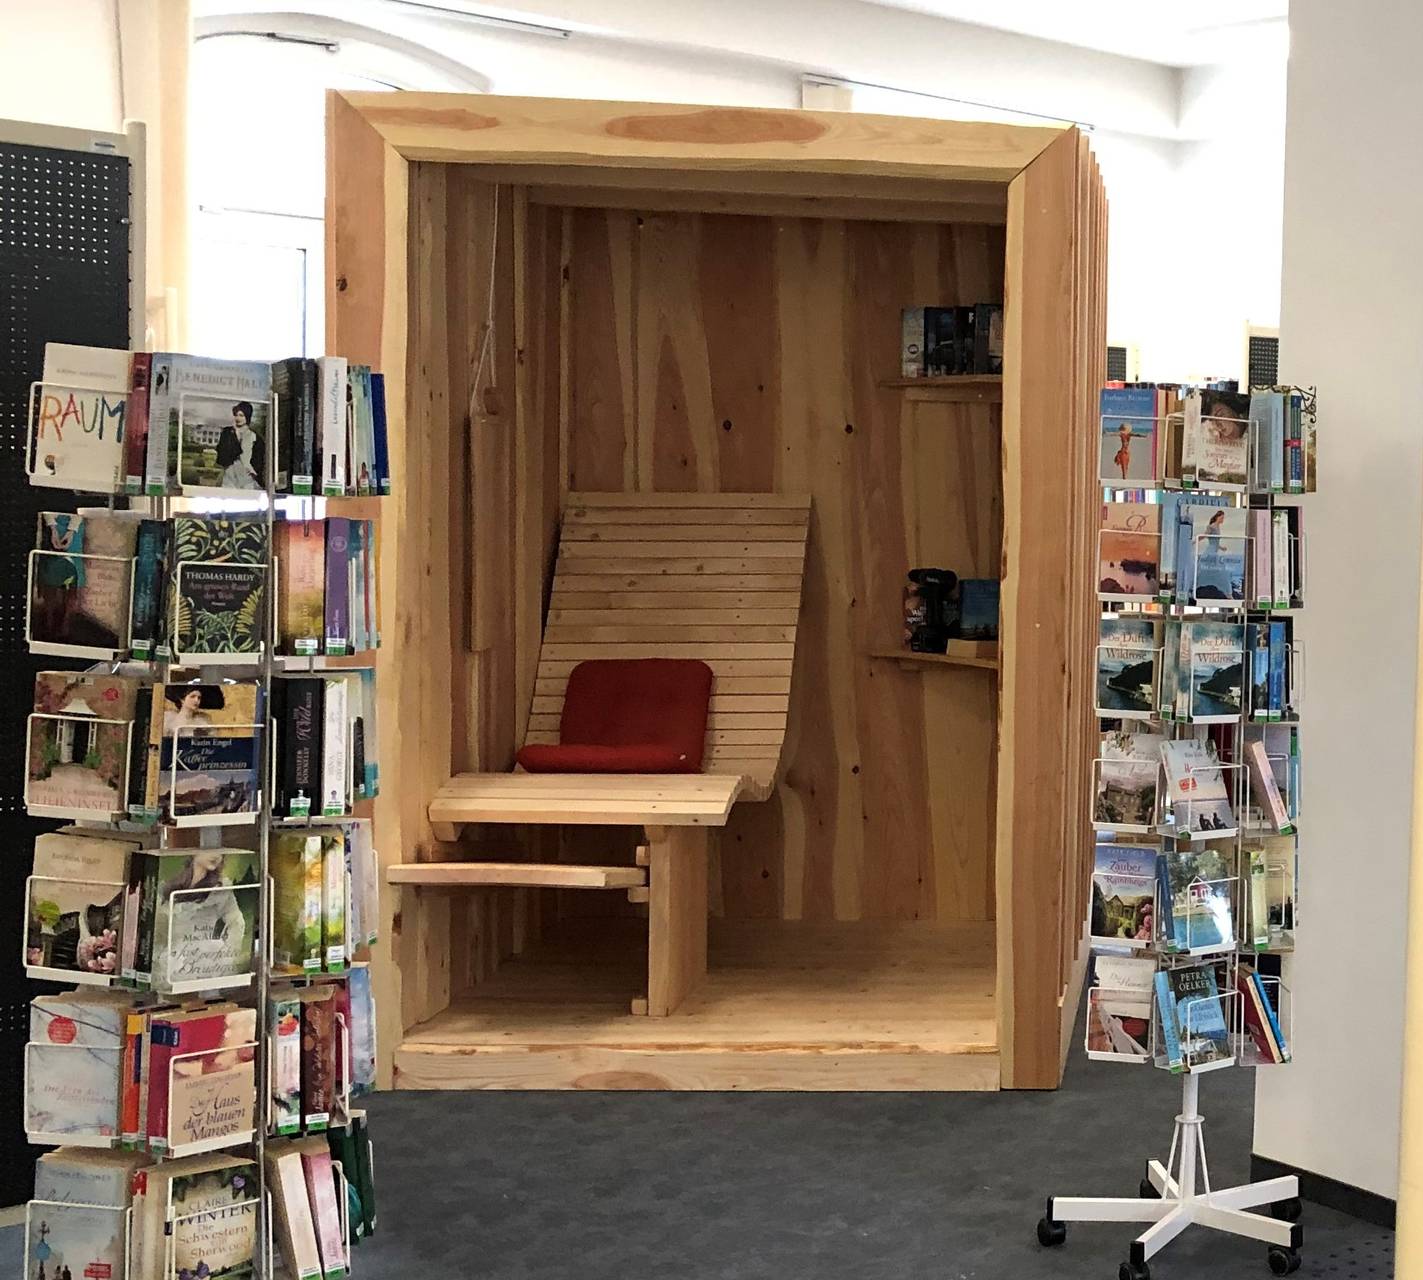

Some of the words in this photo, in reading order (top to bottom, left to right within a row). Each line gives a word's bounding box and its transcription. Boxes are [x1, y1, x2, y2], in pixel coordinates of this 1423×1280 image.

[38, 393, 126, 443] RAUM
[185, 571, 223, 582] THOMAS
[225, 572, 255, 582] HARDY
[1122, 632, 1145, 644] Duft
[1214, 636, 1236, 647] Duft
[1106, 649, 1148, 661] Wildrose
[1198, 653, 1237, 665] Wildrose
[212, 738, 232, 748] Engel
[302, 747, 310, 784] DONNELLY
[1109, 859, 1142, 873] Zauber
[1179, 971, 1208, 982] PETRA
[1178, 979, 1212, 993] OELKER
[183, 1114, 206, 1131] der
[205, 1108, 246, 1126] blauen
[189, 1121, 240, 1142] Mangos
[177, 1204, 254, 1226] WINTER
[178, 1226, 249, 1245] Schwestern
[190, 1240, 253, 1260] Sherwood
